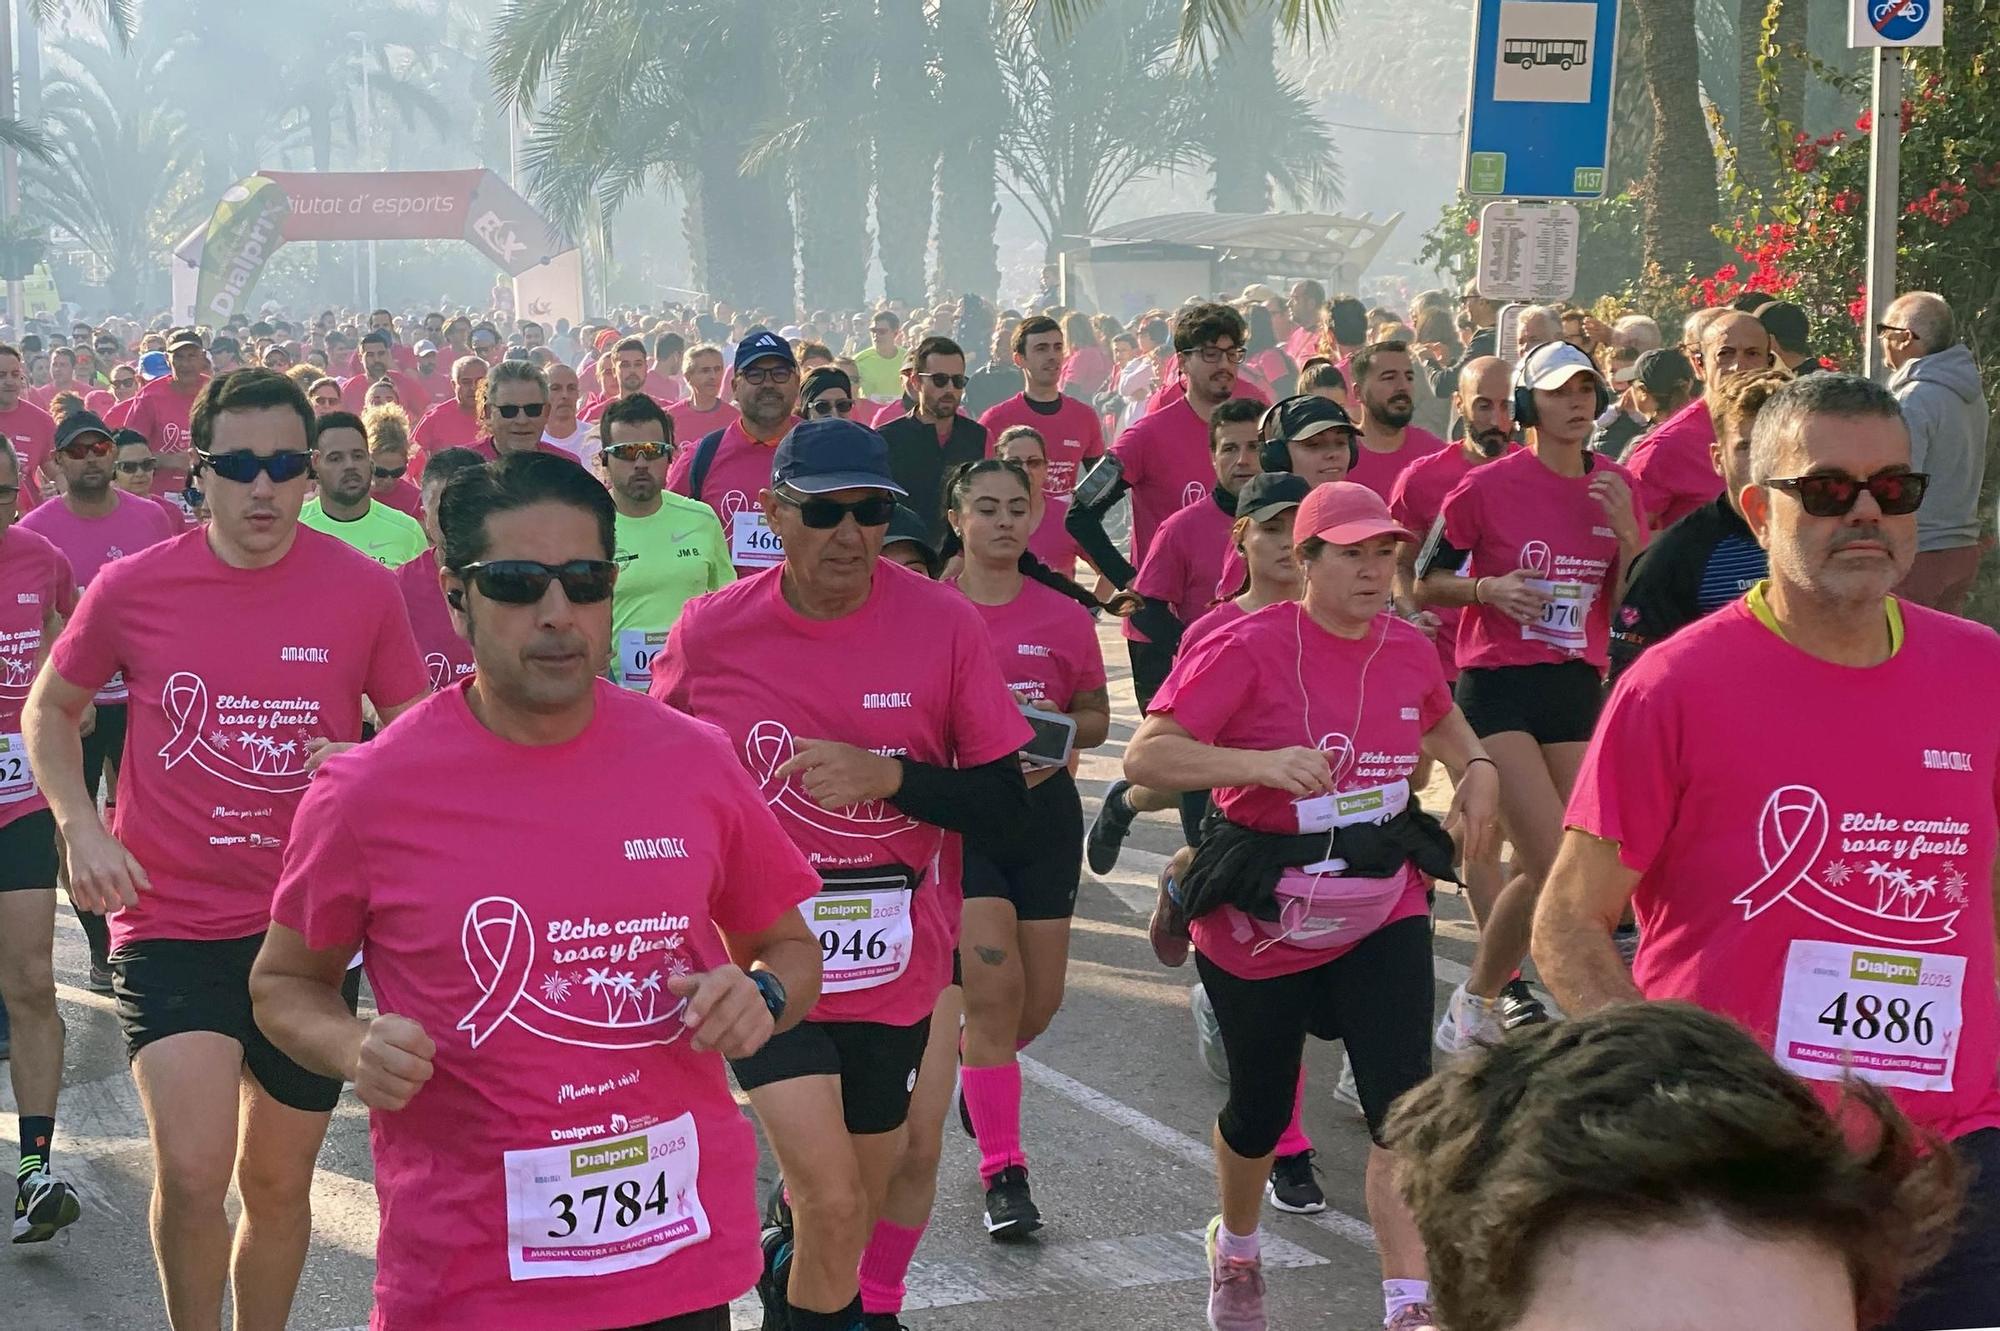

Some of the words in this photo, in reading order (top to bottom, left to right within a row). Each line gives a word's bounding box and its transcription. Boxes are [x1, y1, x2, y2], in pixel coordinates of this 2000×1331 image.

[1577, 173, 1602, 188] 1137
[372, 191, 454, 216] esports
[676, 548, 691, 558] JM
[281, 646, 330, 663] AMACMEC
[215, 695, 261, 710] Elche
[262, 696, 320, 711] camina
[863, 693, 912, 709] AMACMEC
[218, 712, 256, 725] rosa
[257, 713, 269, 729] y
[270, 711, 318, 729] fuerte
[1923, 749, 1973, 771] AMACMEC
[1840, 812, 1899, 832] Elche
[1902, 816, 1970, 836] camina
[624, 837, 689, 860] AMACMEC
[1842, 838, 1893, 853] rosa
[1893, 839, 1910, 859] y
[1909, 834, 1969, 860] fuerte
[818, 904, 869, 916] Dialprix
[546, 915, 612, 943] Elche
[614, 910, 690, 934] camina
[552, 944, 608, 964] rosa
[609, 943, 626, 964] y
[1856, 958, 1917, 978] Dialprix
[1921, 973, 1952, 988] 2023
[1818, 991, 1936, 1046] 4886
[1797, 1047, 1835, 1060] MARCHA
[1870, 1057, 1881, 1066] EL
[1910, 1060, 1922, 1070] DE
[558, 1083, 597, 1105] ¡Mucho
[598, 1078, 616, 1097] por
[551, 1124, 606, 1141] Dialprix
[576, 1145, 645, 1169] Dialprix
[650, 1136, 686, 1161] 2023
[547, 1170, 669, 1238] 3784
[531, 1249, 571, 1258] MARCHA
[571, 1248, 609, 1257] CONTRA
[608, 1246, 619, 1254] EL
[653, 1231, 665, 1243] DE
[664, 1223, 690, 1240] MAMA
